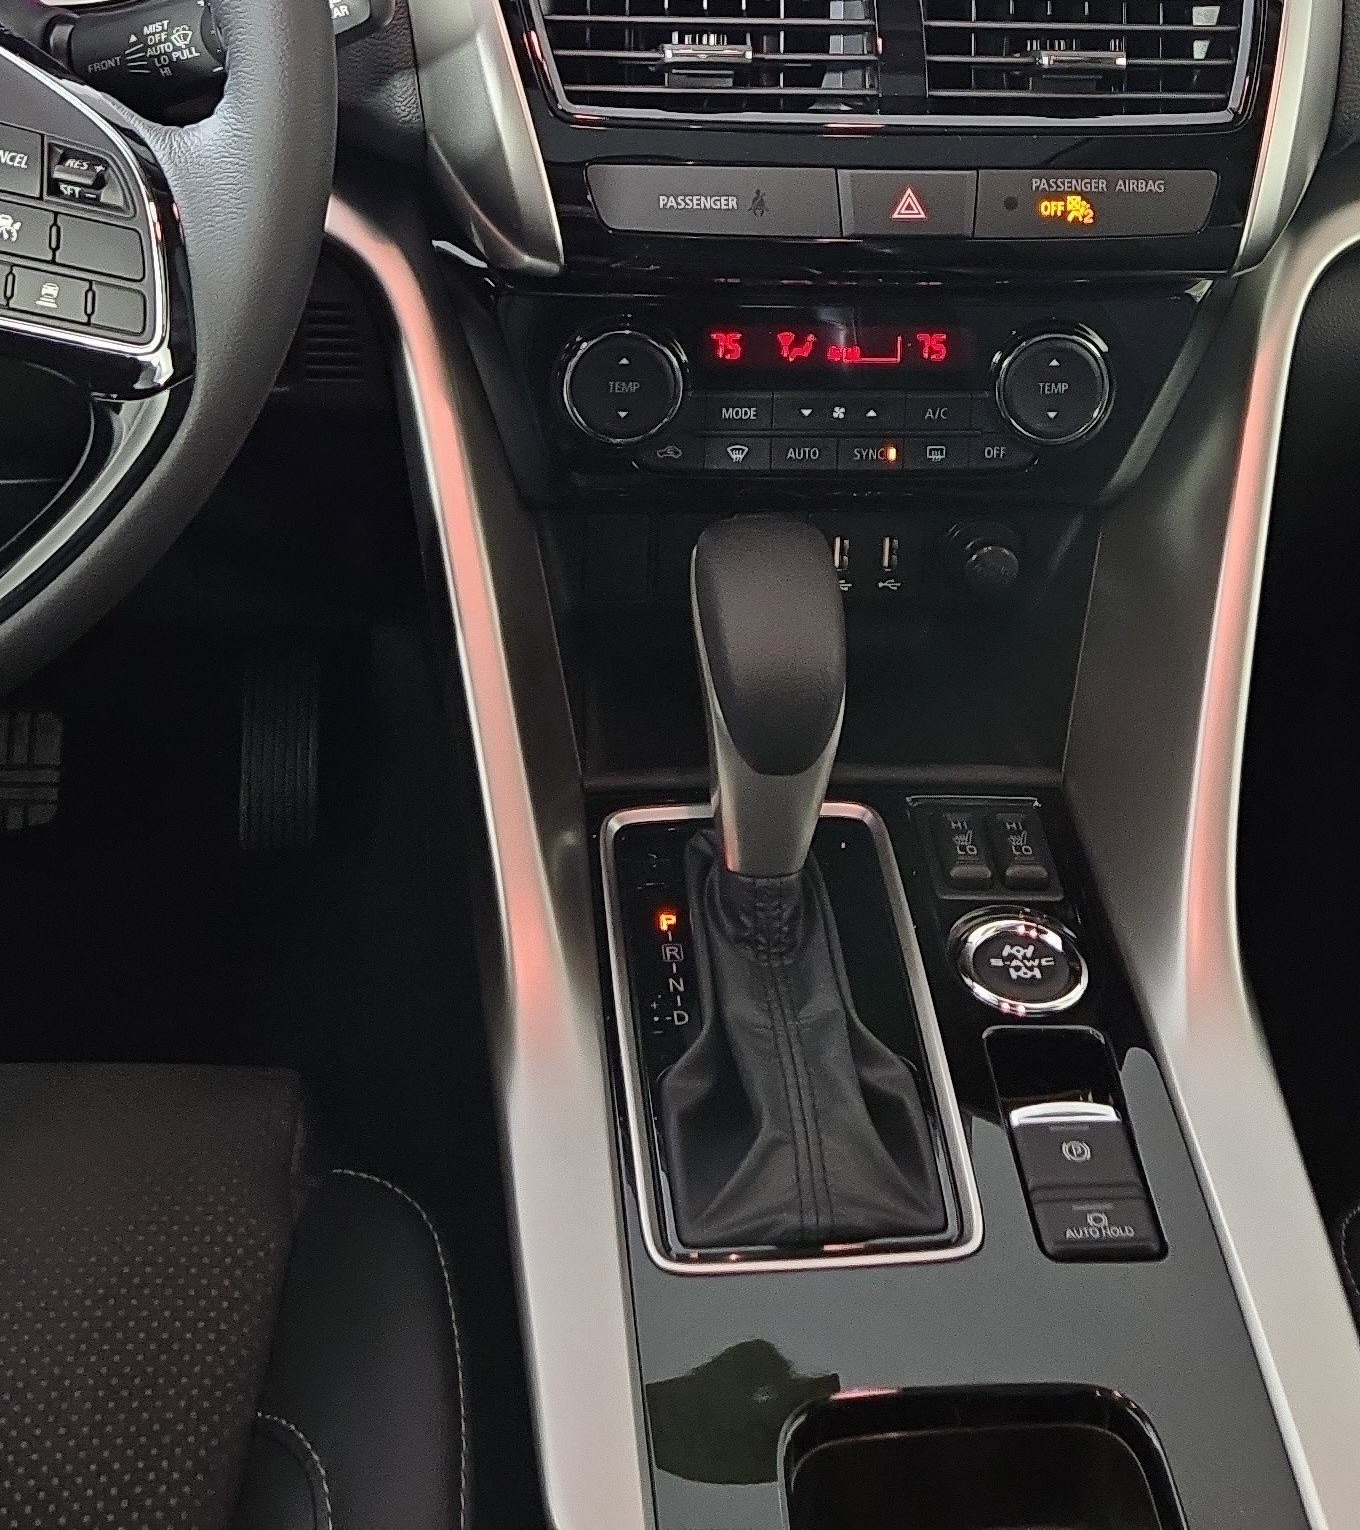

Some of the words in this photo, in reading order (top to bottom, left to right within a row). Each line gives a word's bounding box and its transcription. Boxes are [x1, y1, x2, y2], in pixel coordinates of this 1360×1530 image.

[143, 20, 170, 36] MIST
[147, 31, 168, 46] OFF
[146, 42, 173, 57] AUTO
[171, 46, 200, 62] PULL
[88, 56, 121, 73] FRONT
[154, 55, 169, 67] LO
[65, 158, 89, 171] RES
[1032, 178, 1107, 191] PASSENGER
[1115, 179, 1165, 192] AIRBAG
[659, 193, 738, 211] PASSENGER
[1040, 201, 1065, 216] OFF
[711, 332, 742, 360] 75
[917, 333, 947, 361] 75
[608, 381, 640, 394] TEMP
[1038, 382, 1069, 395] TEMP
[721, 407, 757, 420] MODE
[924, 407, 948, 420] A/C
[786, 447, 819, 460] AUTO
[853, 447, 885, 460] SYNC
[984, 446, 1007, 459] OFF
[659, 913, 677, 932] P
[665, 946, 681, 960] R
[990, 957, 1055, 967] S-AWC
[668, 977, 684, 992] N
[673, 1010, 689, 1025] D
[1065, 1226, 1099, 1239] AUTO
[1102, 1226, 1135, 1239] HOLD
